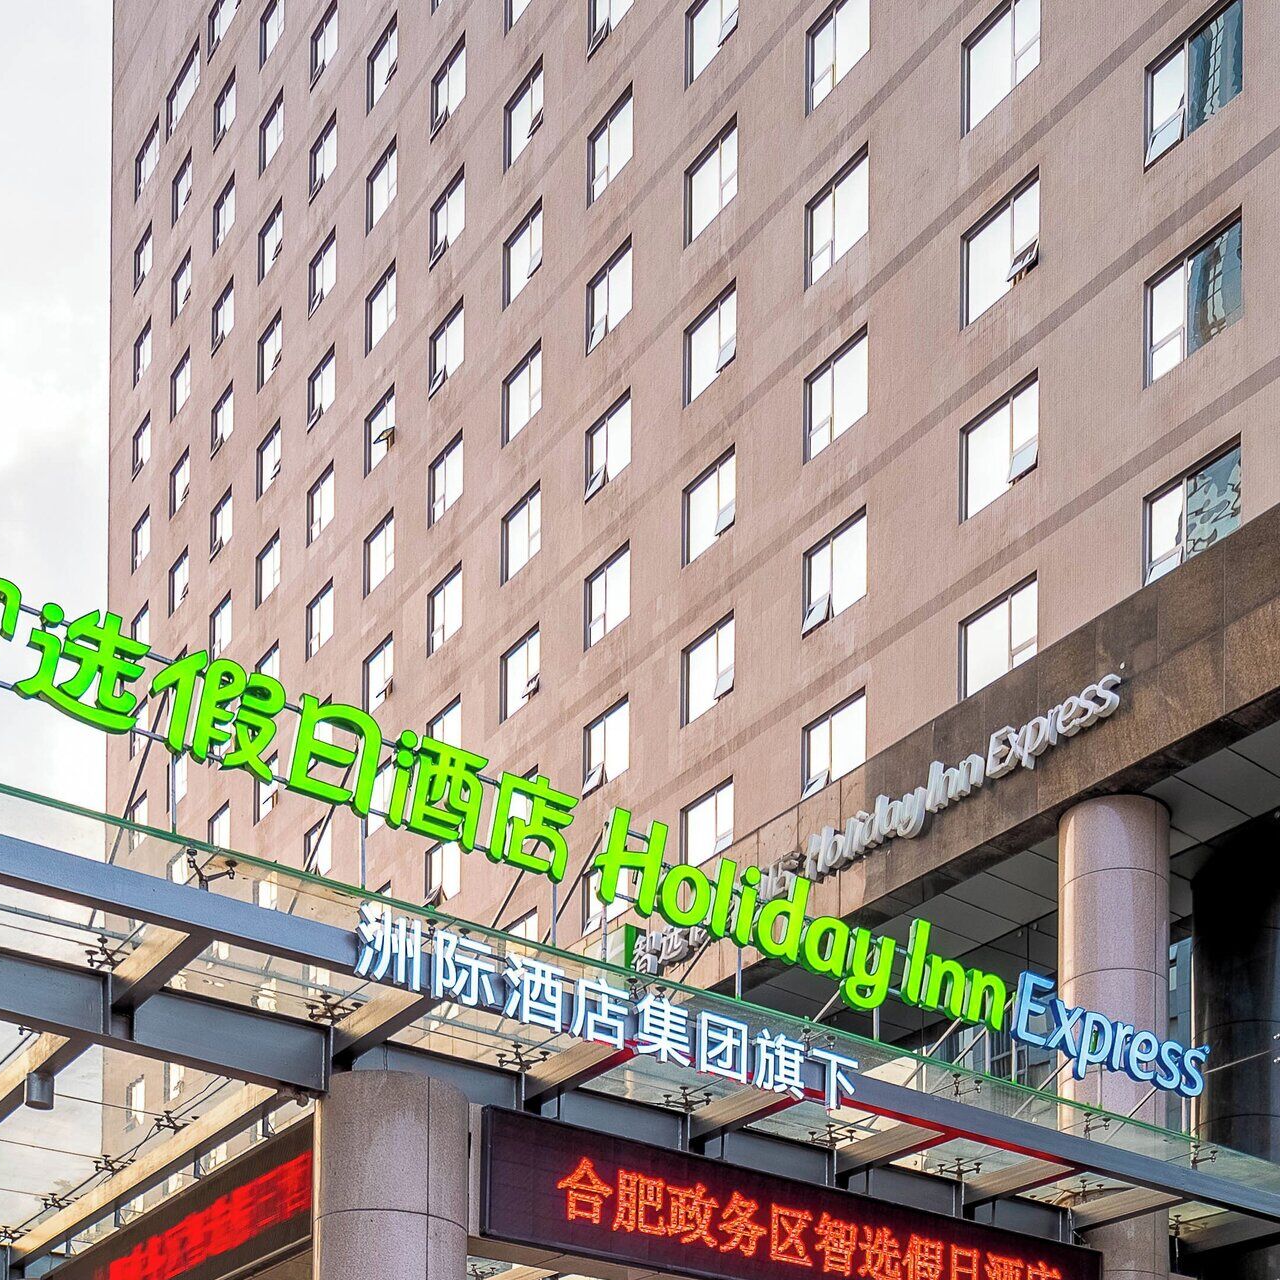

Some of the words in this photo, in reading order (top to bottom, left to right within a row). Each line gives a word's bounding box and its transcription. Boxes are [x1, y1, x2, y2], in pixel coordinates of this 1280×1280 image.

[804, 786, 928, 880] Holiday
[925, 760, 986, 814] Inn
[985, 672, 1122, 780] Express
[354, 900, 859, 1111] 洲际酒店集团旗下
[595, 806, 896, 1012] Holiday
[900, 917, 1007, 1033] Inn
[1009, 970, 1208, 1099] Express
